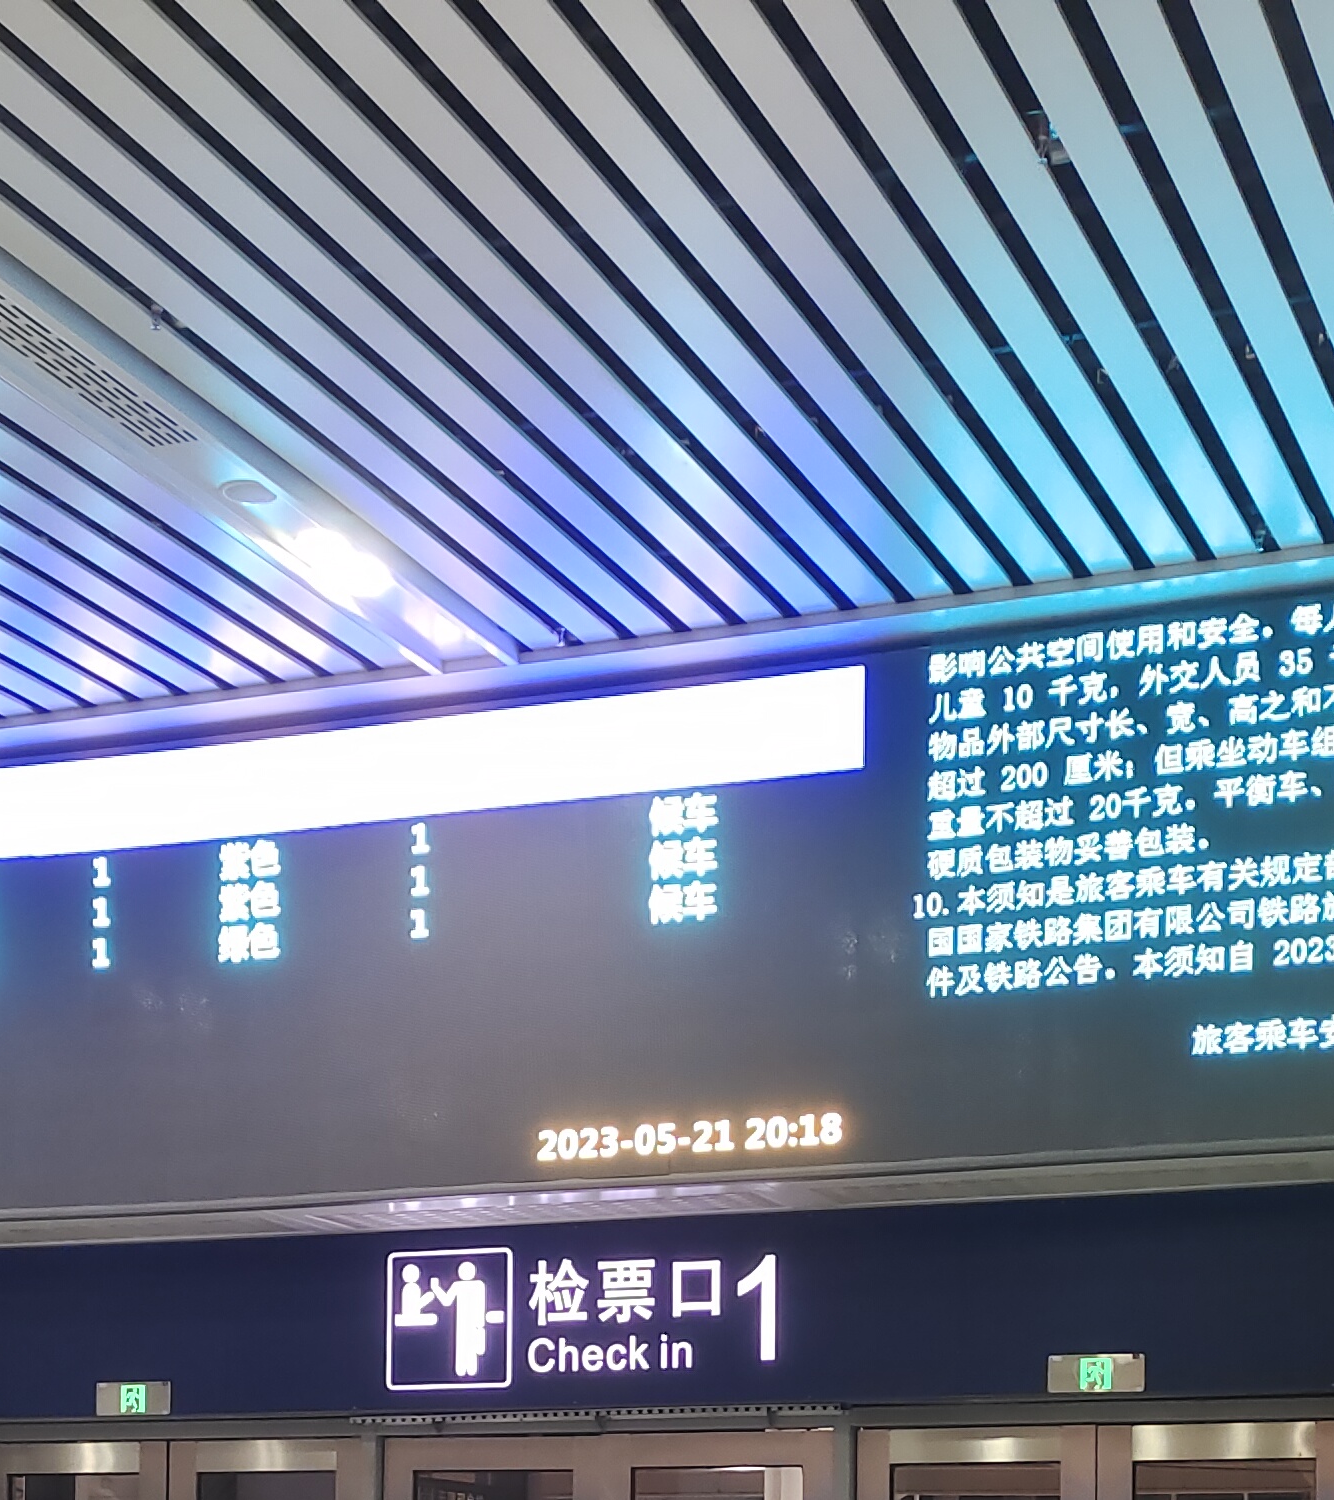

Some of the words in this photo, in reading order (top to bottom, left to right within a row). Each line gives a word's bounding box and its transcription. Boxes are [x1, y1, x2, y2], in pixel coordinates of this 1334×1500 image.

[929, 688, 986, 724] 儿童
[1003, 684, 1033, 711] 10
[1279, 648, 1313, 677] 35
[927, 766, 986, 801] 超过
[1001, 762, 1047, 791] 200
[927, 796, 1074, 840] 重量不超过
[93, 857, 110, 888] 1
[411, 824, 429, 855] 1
[93, 898, 110, 928] 1
[411, 867, 429, 897] 1
[93, 939, 110, 969] 1
[411, 910, 429, 939] 1
[536, 1121, 734, 1161] 2023-05-21
[745, 1112, 842, 1151] 20:18
[530, 1257, 723, 1326] 检票口
[736, 1254, 777, 1362] 1
[527, 1335, 650, 1373] Check
[660, 1334, 693, 1369] in
